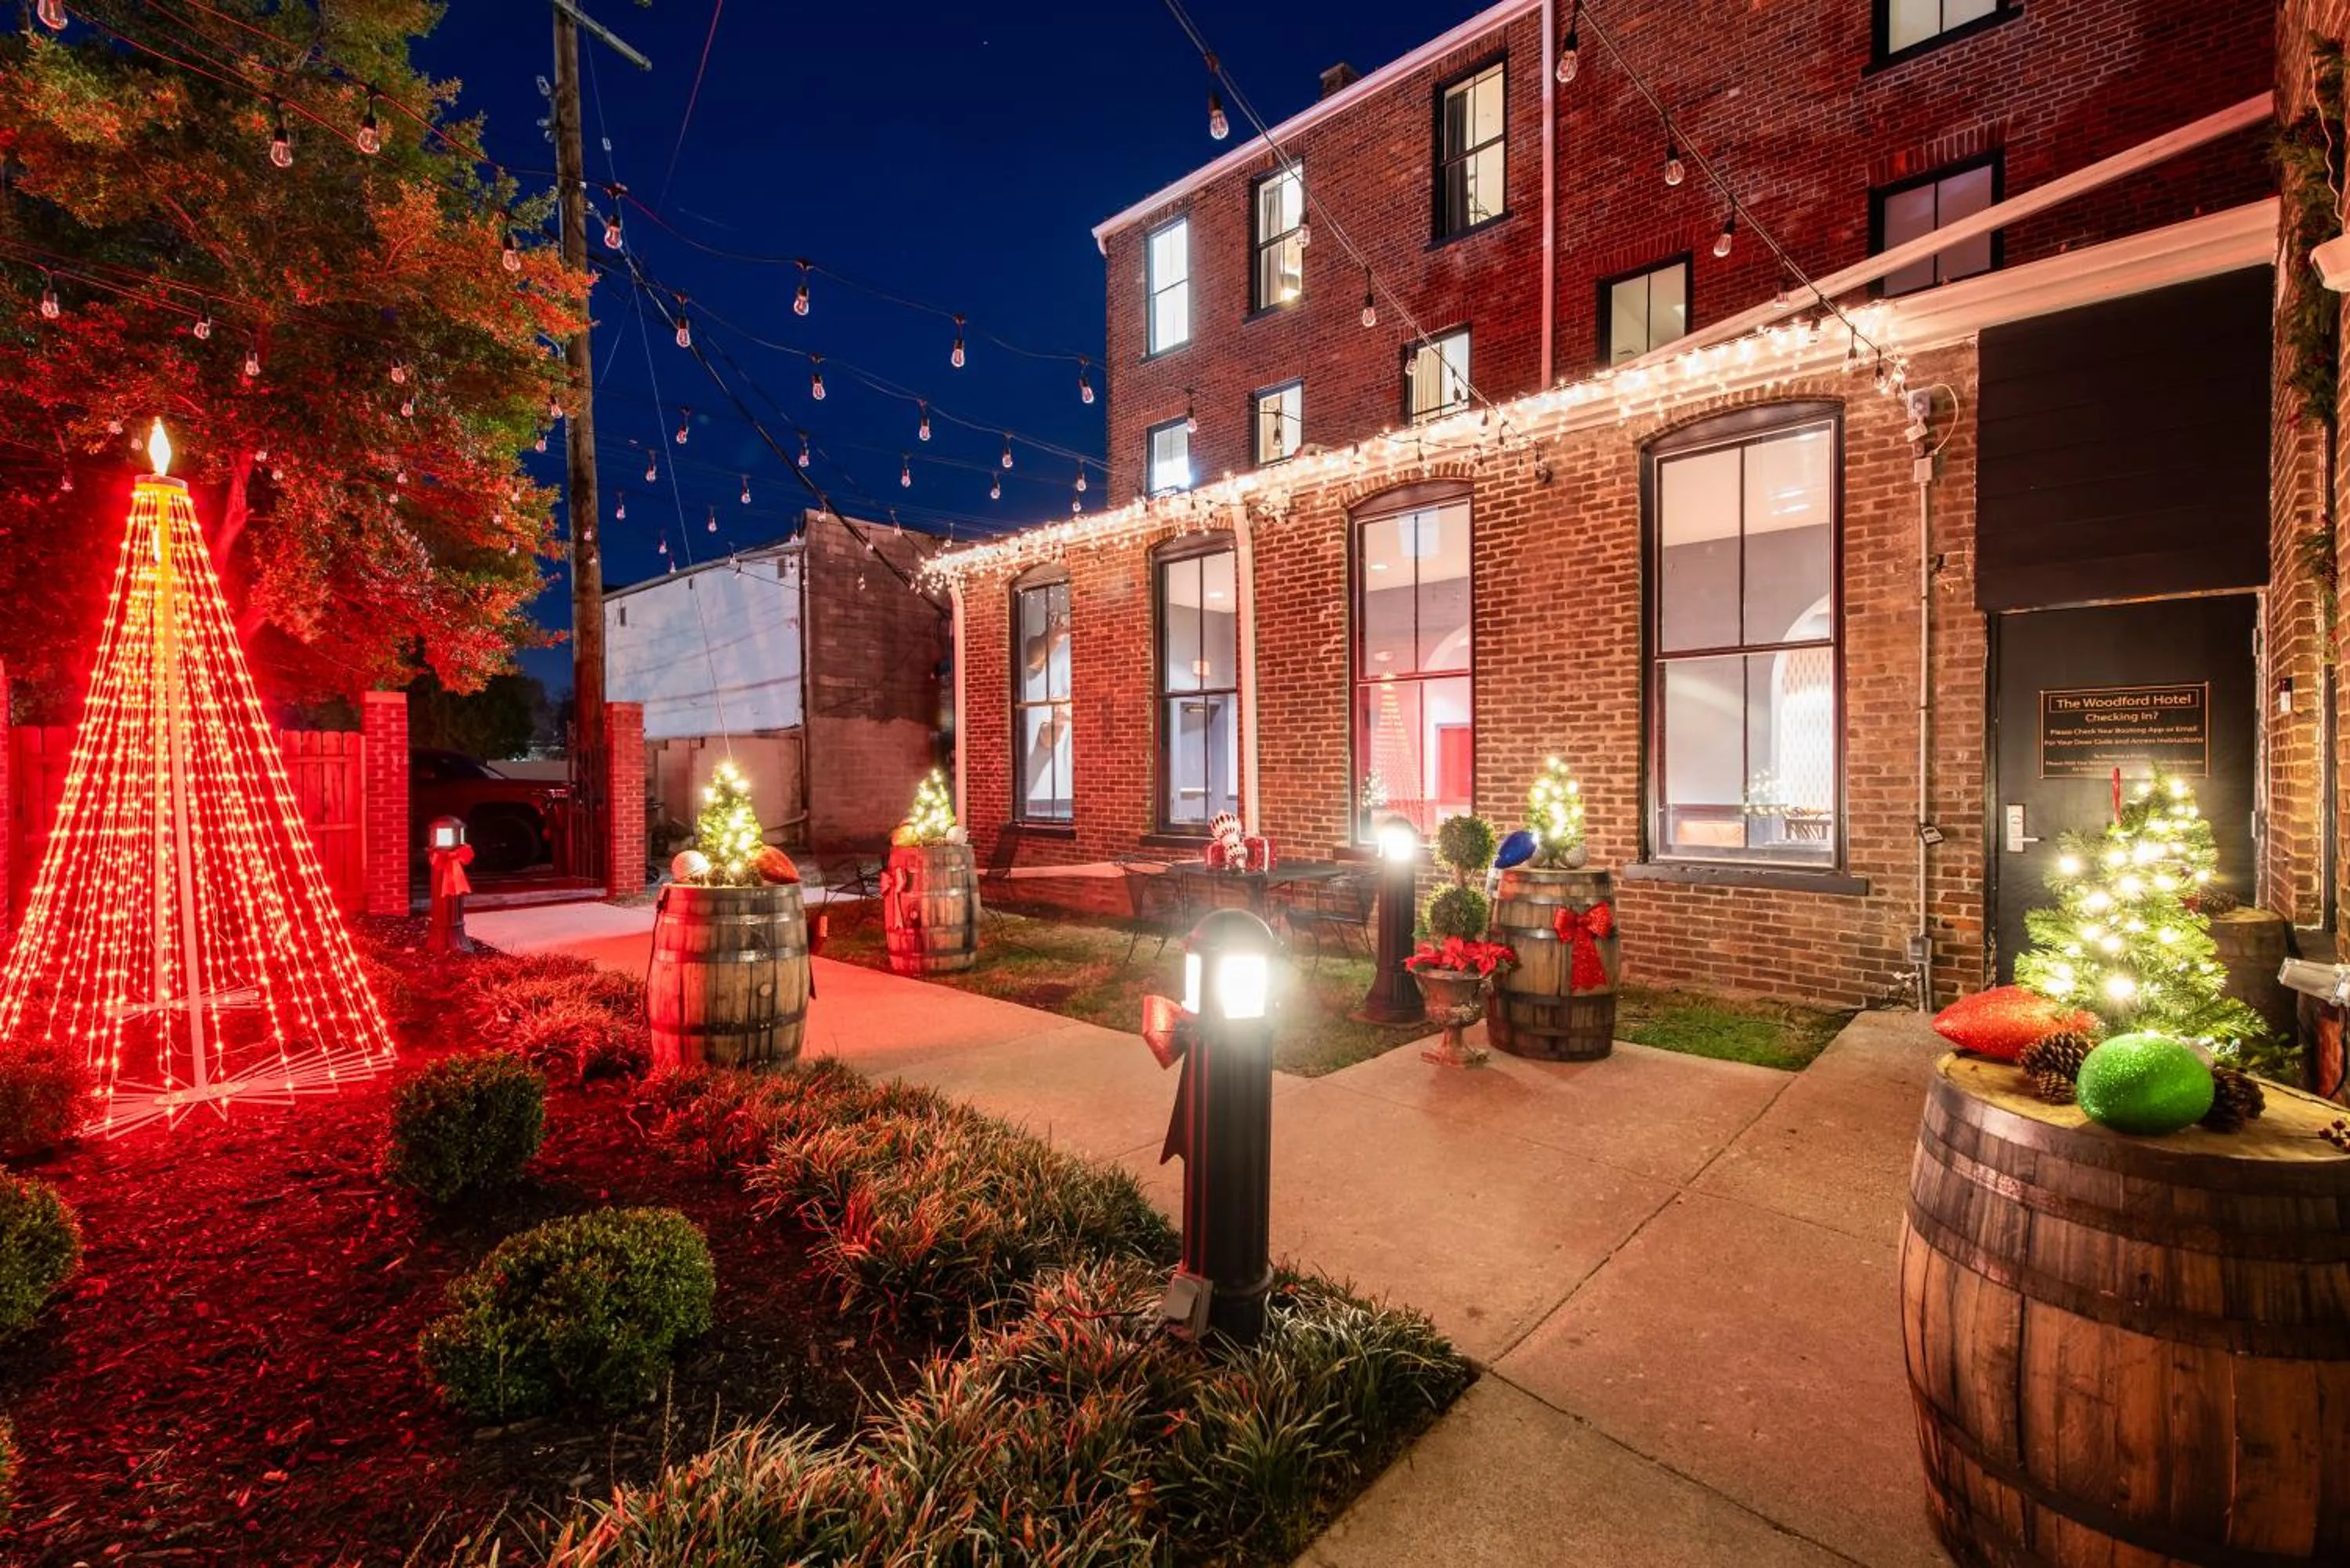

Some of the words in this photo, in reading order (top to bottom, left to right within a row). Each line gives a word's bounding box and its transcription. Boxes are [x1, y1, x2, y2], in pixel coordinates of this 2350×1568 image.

[2056, 698, 2081, 709] The
[2083, 695, 2149, 707] Woodford
[2153, 693, 2191, 705] Hotel
[2084, 712, 2138, 722] Checking
[2141, 710, 2159, 720] In?
